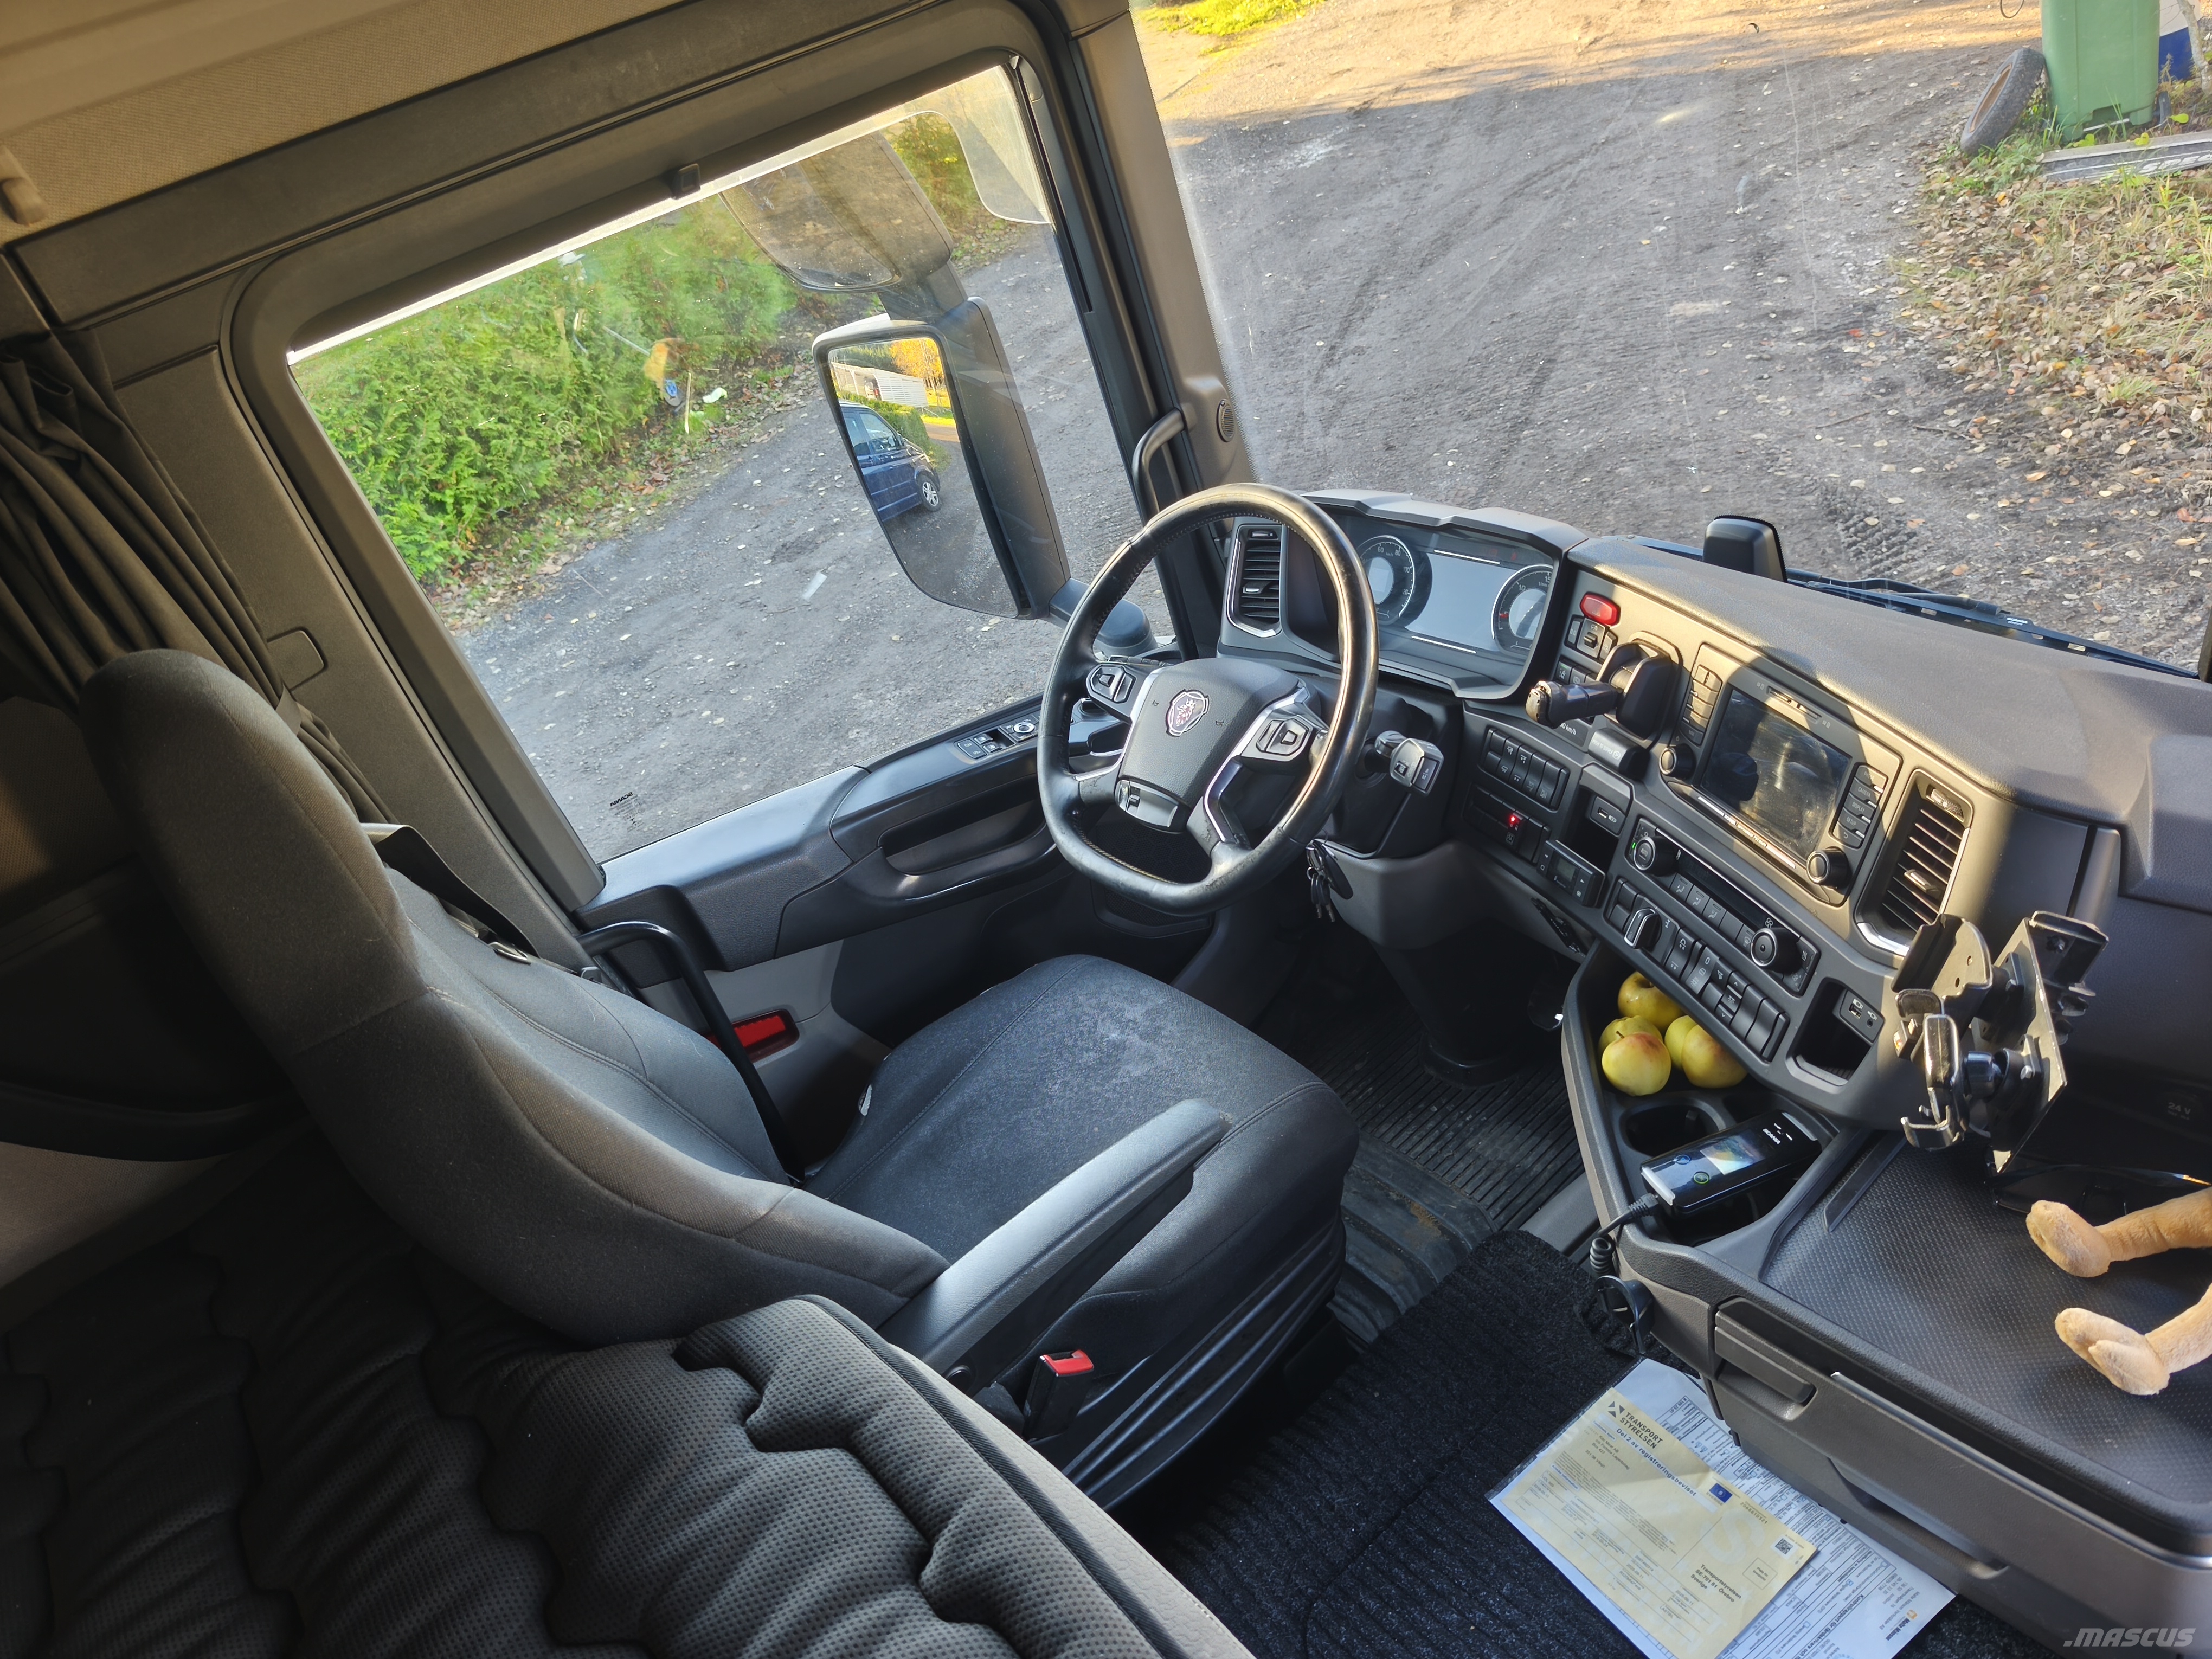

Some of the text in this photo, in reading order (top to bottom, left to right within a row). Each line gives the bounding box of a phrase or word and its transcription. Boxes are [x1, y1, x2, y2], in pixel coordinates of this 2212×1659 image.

[1566, 725, 1577, 735] km/h
[1857, 786, 1872, 798] CAMERA
[1851, 801, 1865, 813] DISPLAY
[1845, 816, 1857, 826] SETUP
[2168, 1102, 2181, 1111] 24
[1763, 1128, 1780, 1144] SCANIA
[1619, 1417, 1657, 1449] STYRELSEN
[1624, 1412, 1663, 1444] TRANSPORT
[1616, 1427, 1627, 1438] Del
[1630, 1441, 1638, 1449] av
[1638, 1447, 1697, 1496] registreringsbeviset
[1740, 1501, 1767, 1525] 2068610321
[1690, 1573, 1708, 1590] Sverige
[1695, 1568, 1712, 1583] SE-701
[1718, 1587, 1735, 1603] Örebro
[1700, 1564, 1742, 1599] Transportstyrelsen
[1833, 1593, 1864, 1622] Kontrollrapport
[1829, 1621, 1837, 1629] för
[1898, 1617, 1910, 1629] Malte
[1885, 1626, 1901, 1641] Månson
[1799, 1648, 1809, 1657] och
